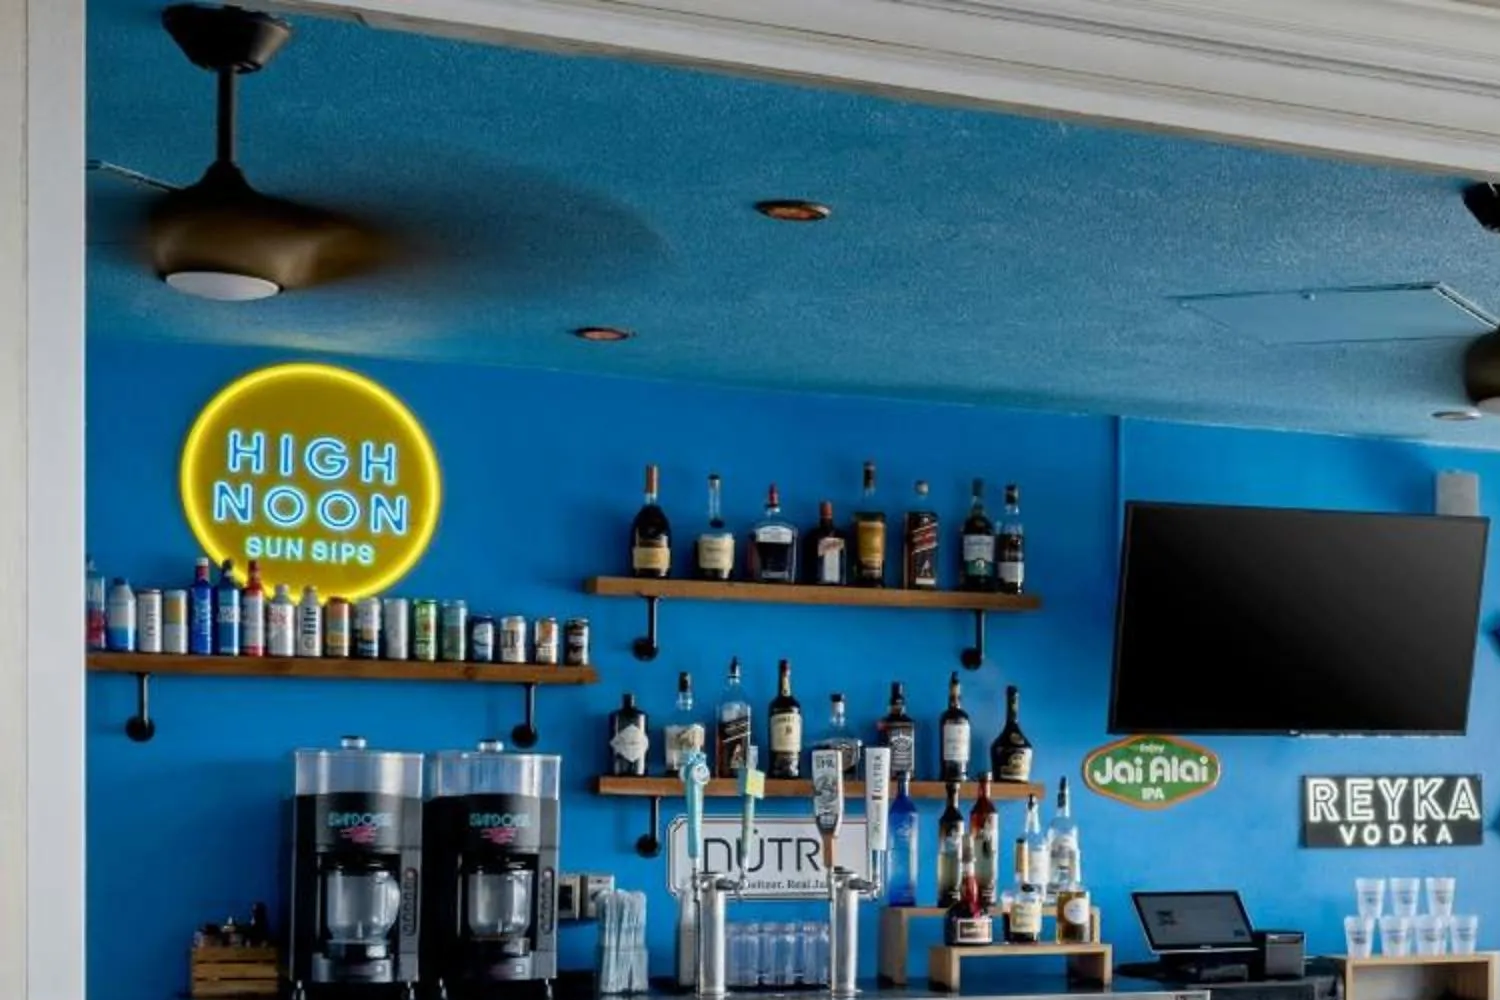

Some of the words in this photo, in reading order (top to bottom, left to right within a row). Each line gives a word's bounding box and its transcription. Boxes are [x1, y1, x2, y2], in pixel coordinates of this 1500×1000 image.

[228, 430, 397, 486] HIGH
[213, 480, 408, 535] NOON
[245, 535, 304, 560] SUN
[311, 540, 375, 565] SIPS
[1093, 756, 1144, 785] Jai
[1150, 755, 1209, 783] Alai
[1141, 787, 1165, 801] IPA
[1306, 776, 1482, 823] REYKA
[1338, 822, 1454, 846] VODKA
